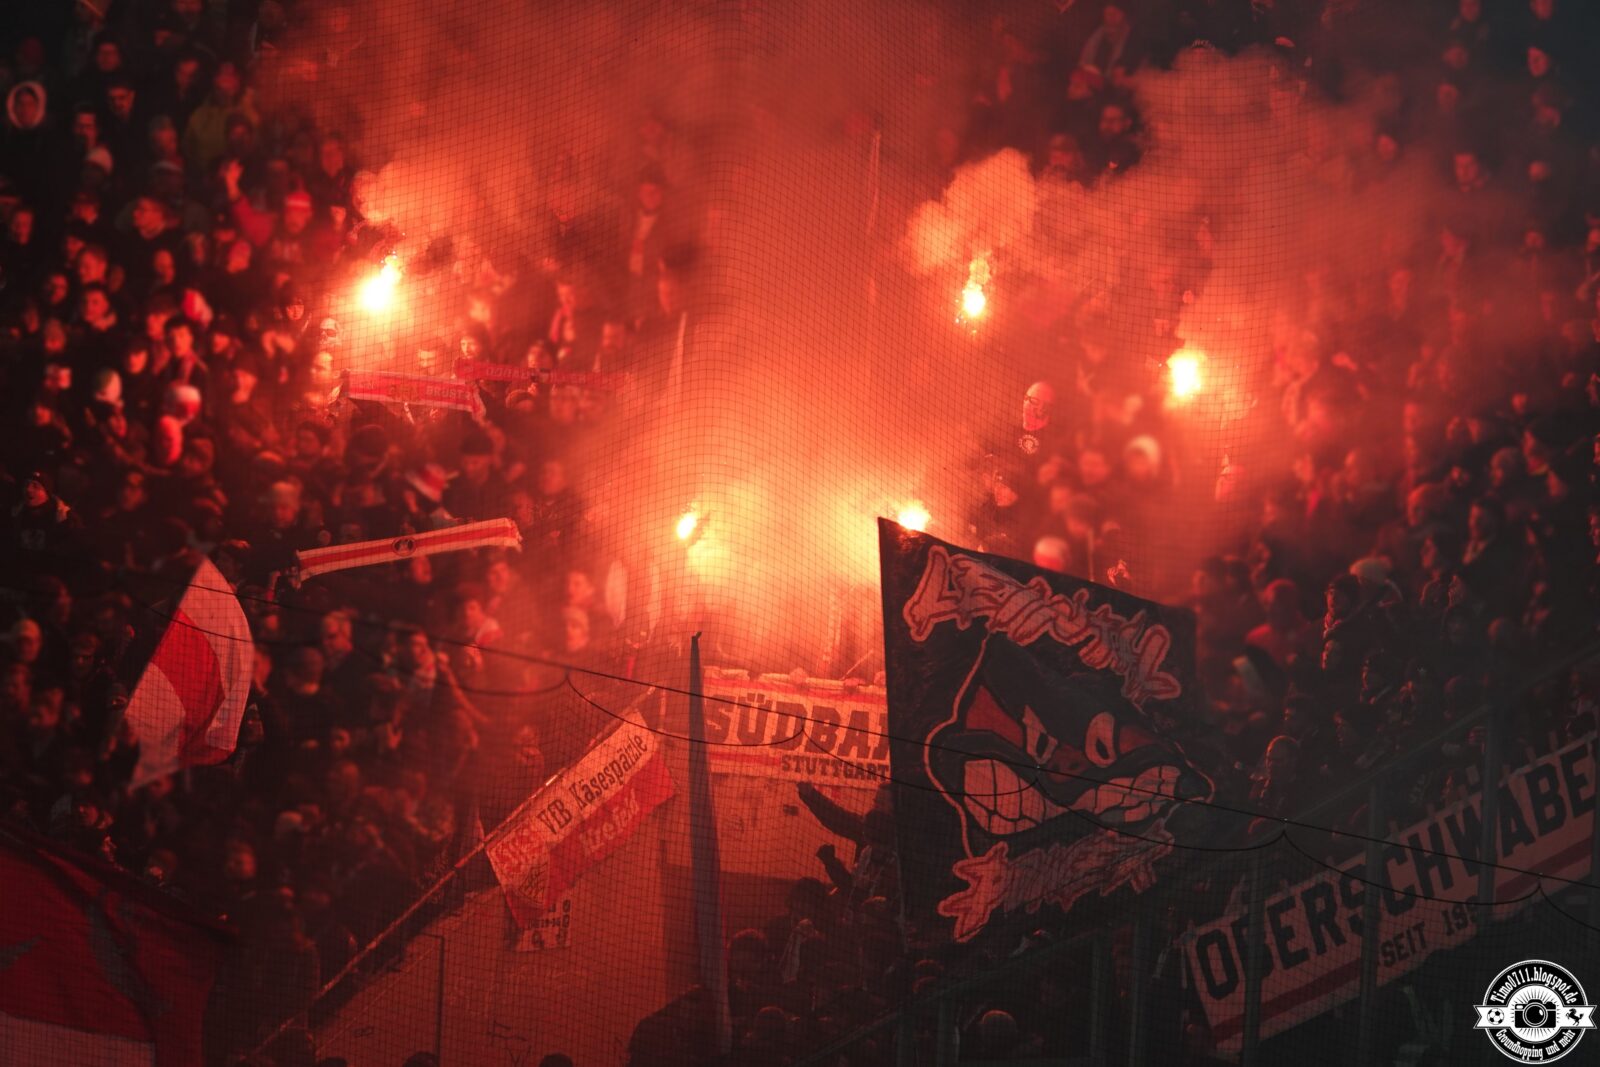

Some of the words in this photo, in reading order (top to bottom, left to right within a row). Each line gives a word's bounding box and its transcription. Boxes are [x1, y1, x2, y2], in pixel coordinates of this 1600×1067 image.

[537, 798, 573, 835] VfB
[569, 734, 648, 811] Käsespätzle
[780, 754, 889, 782] STUTTGART
[1196, 738, 1600, 1000] OBERSCHWABE
[1380, 920, 1427, 967] SEIT
